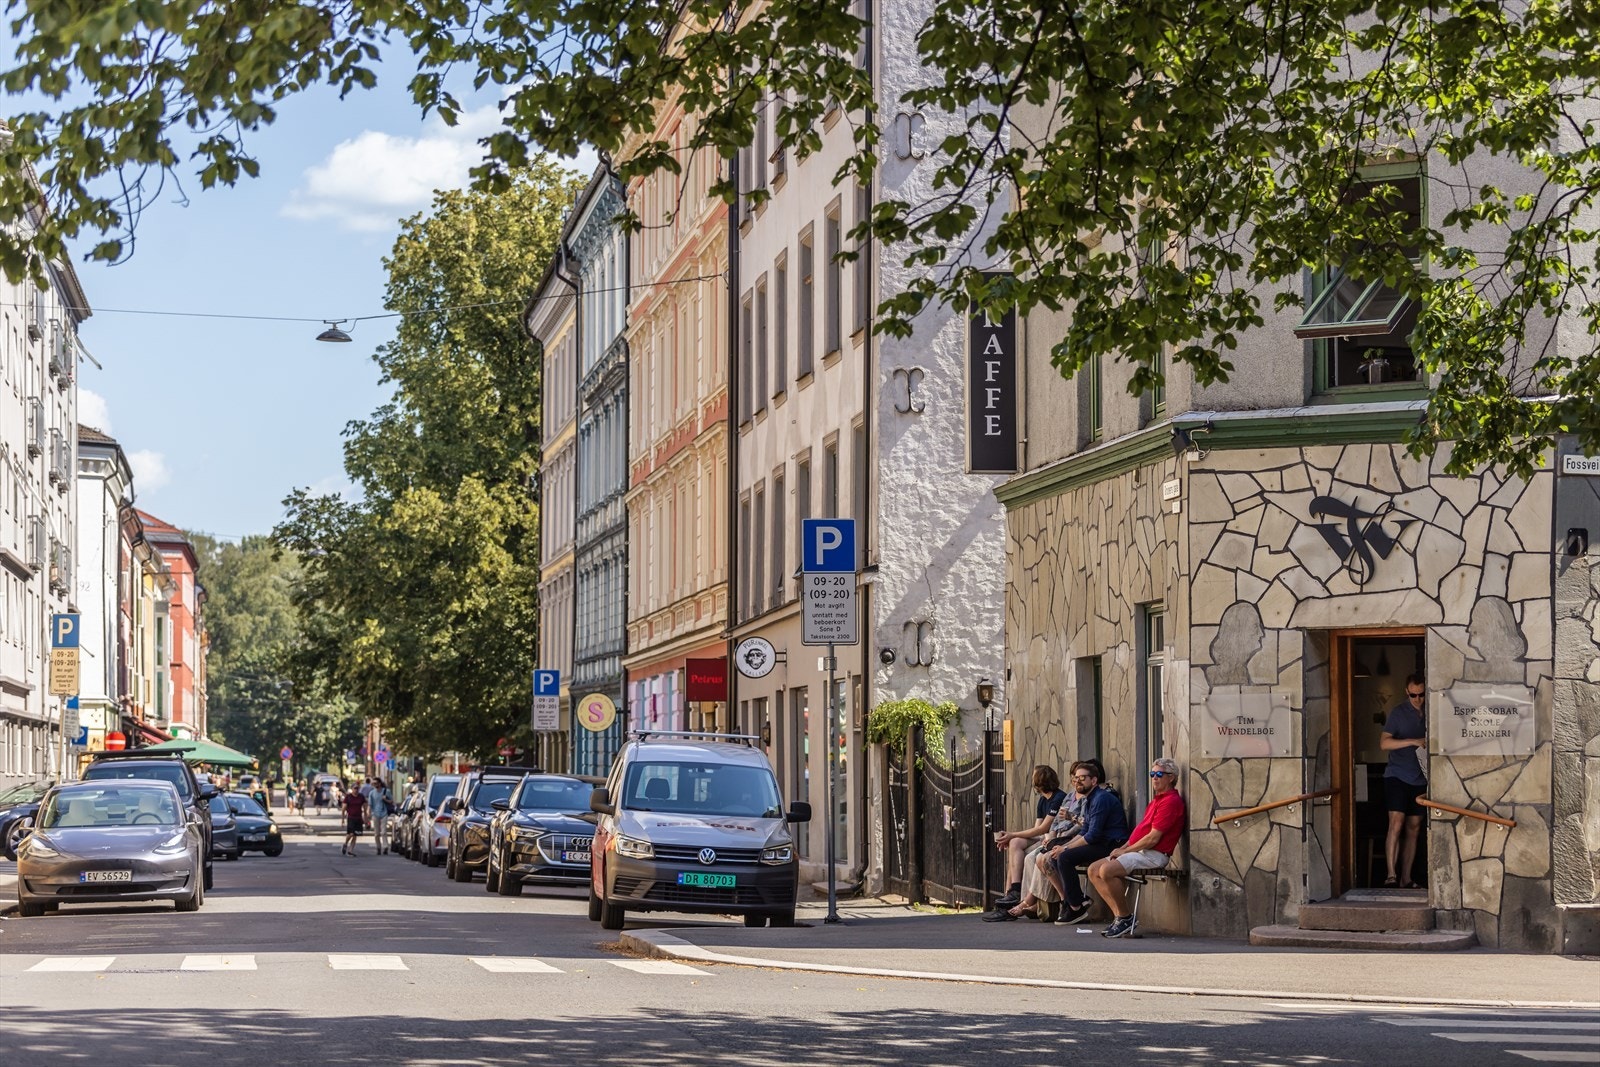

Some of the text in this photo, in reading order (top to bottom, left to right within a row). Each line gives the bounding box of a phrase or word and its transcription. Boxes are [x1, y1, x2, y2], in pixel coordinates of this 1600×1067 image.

[816, 526, 843, 565] P
[58, 618, 74, 644] P
[540, 673, 554, 693] P
[691, 675, 723, 684] Petrus
[588, 701, 604, 723] S
[1453, 706, 1519, 716] ESPRESSOBAR
[1237, 715, 1255, 725] TIM
[1470, 717, 1500, 727] SKOLE
[1217, 727, 1275, 736] WENDELBOE
[1461, 728, 1511, 738] BRENNERI
[568, 852, 577, 860] EC
[87, 871, 129, 881] EV 56529
[685, 874, 733, 885] DR 80703
